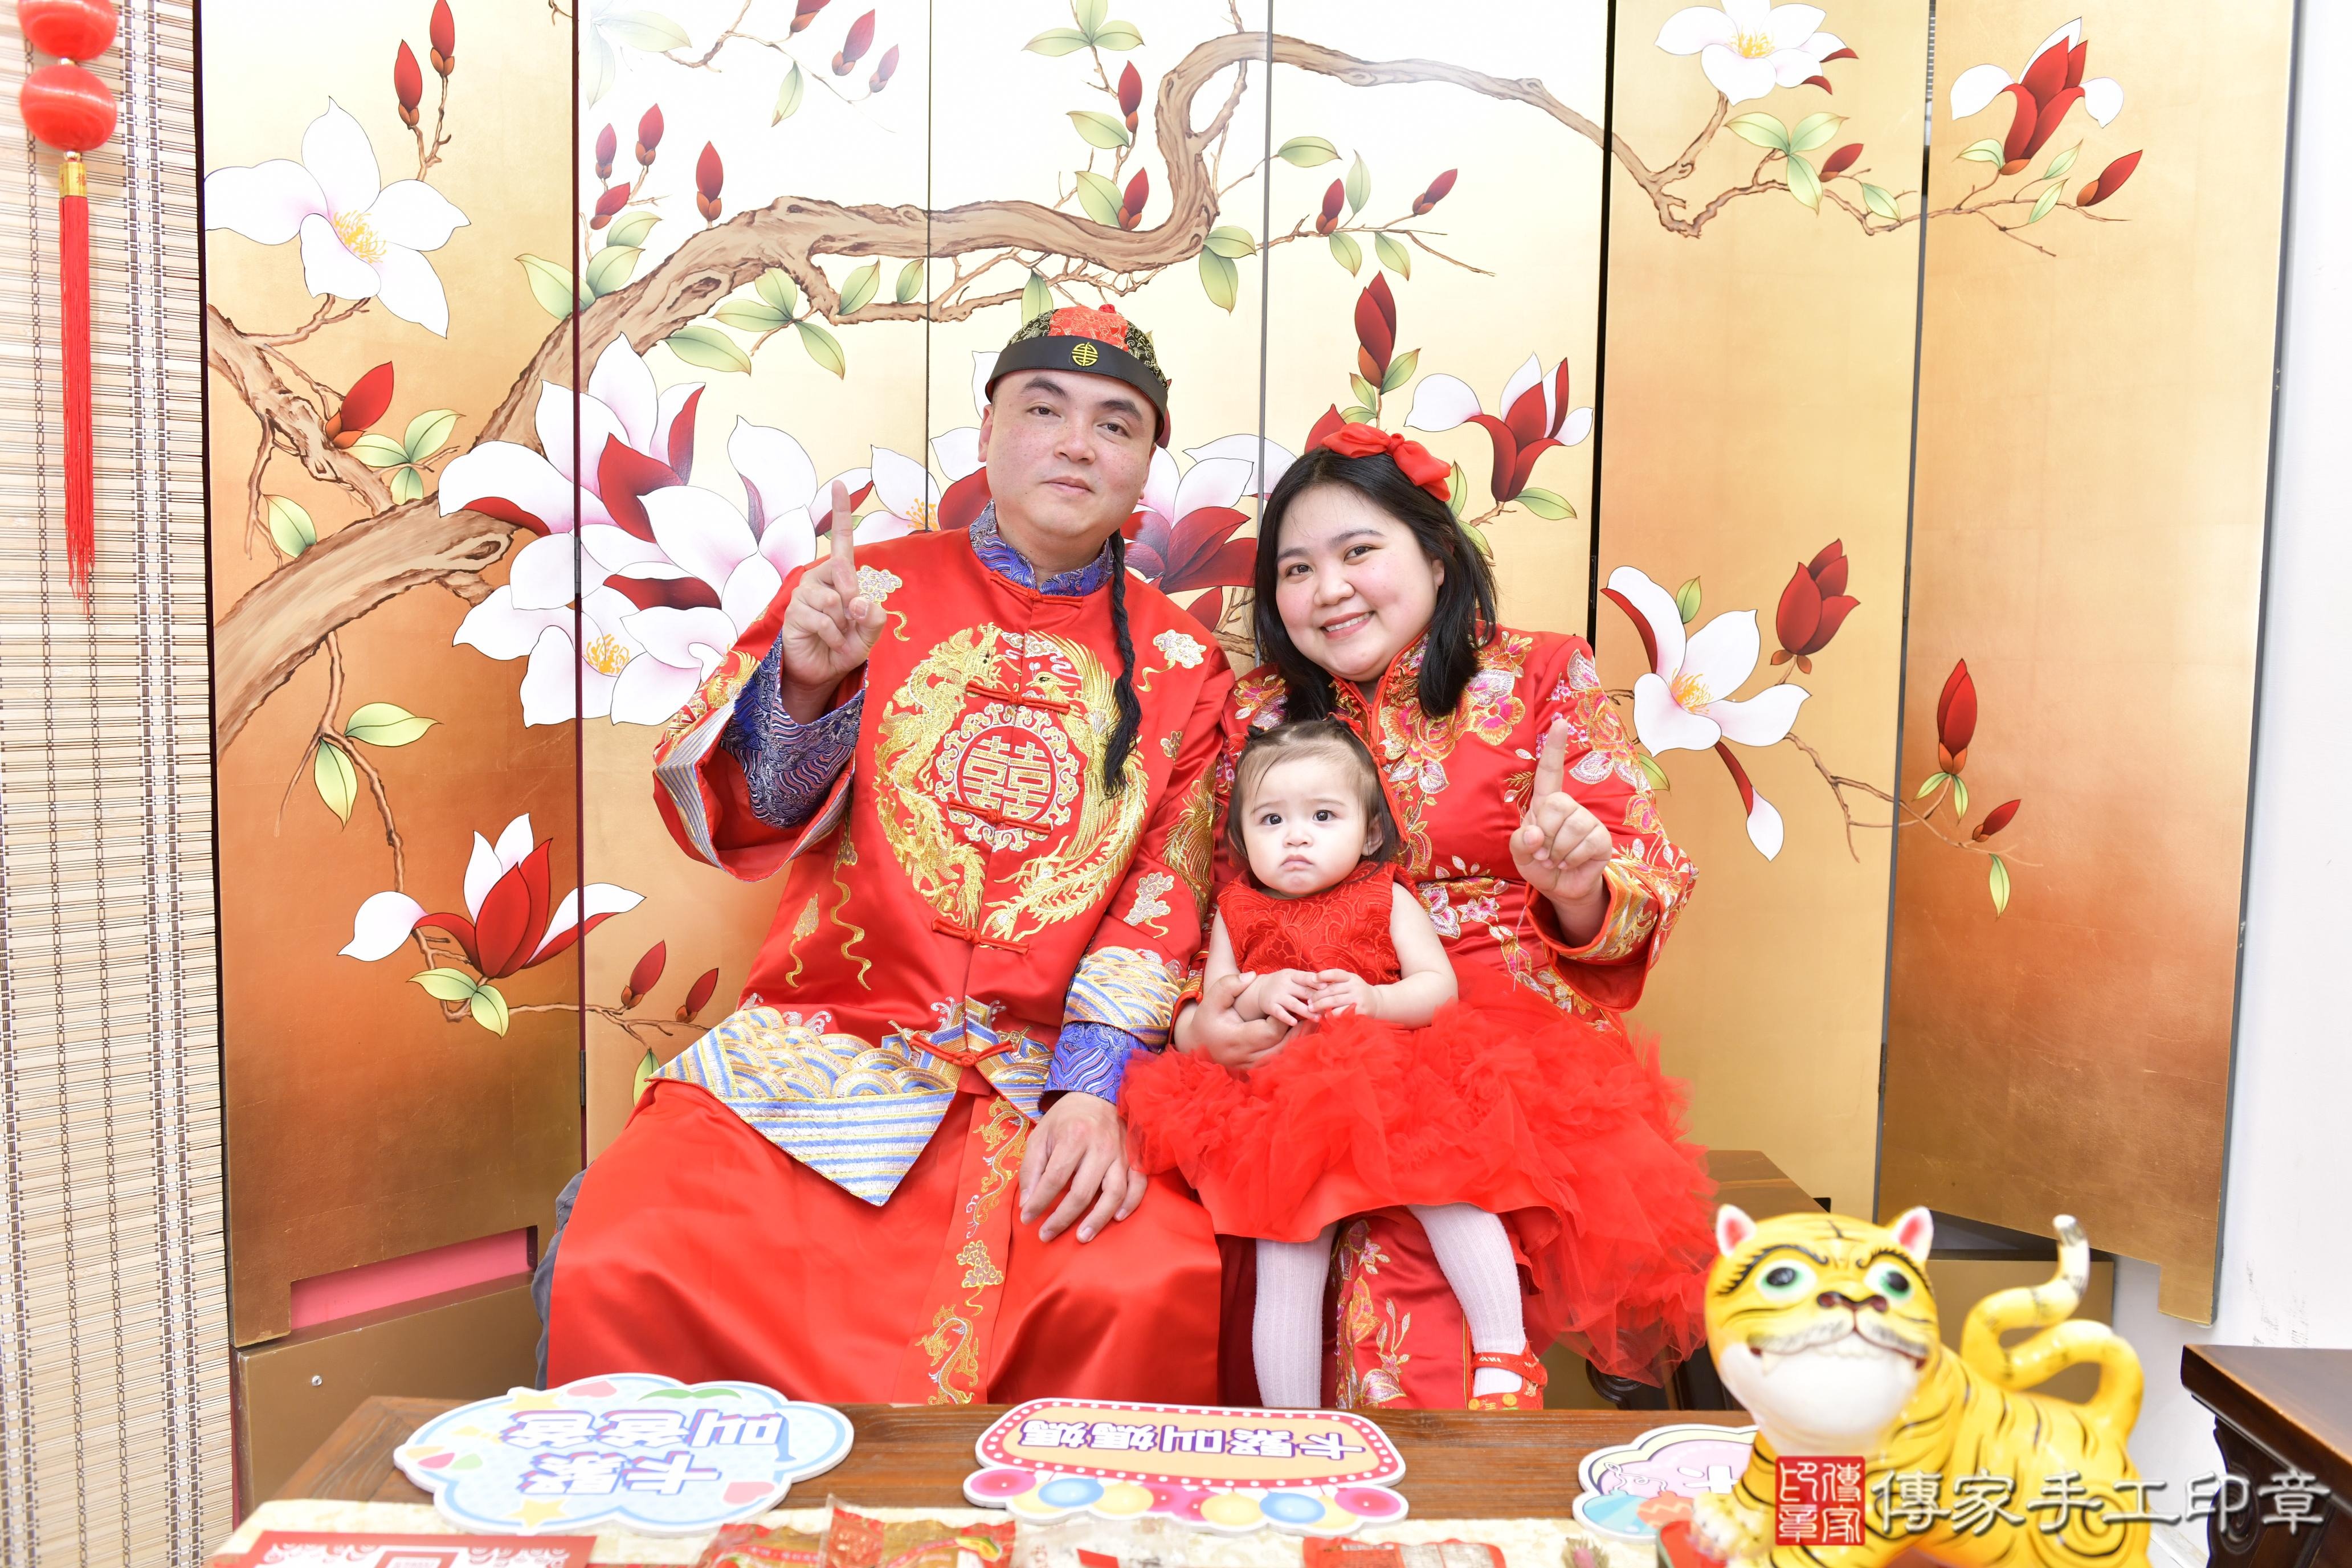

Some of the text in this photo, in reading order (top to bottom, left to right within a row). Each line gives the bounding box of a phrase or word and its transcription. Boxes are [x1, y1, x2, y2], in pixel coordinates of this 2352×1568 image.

[499, 1408, 786, 1449] 叫爸爸
[1021, 1419, 1366, 1461] 卡緊叫媽媽
[518, 1450, 722, 1495] 卡緊
